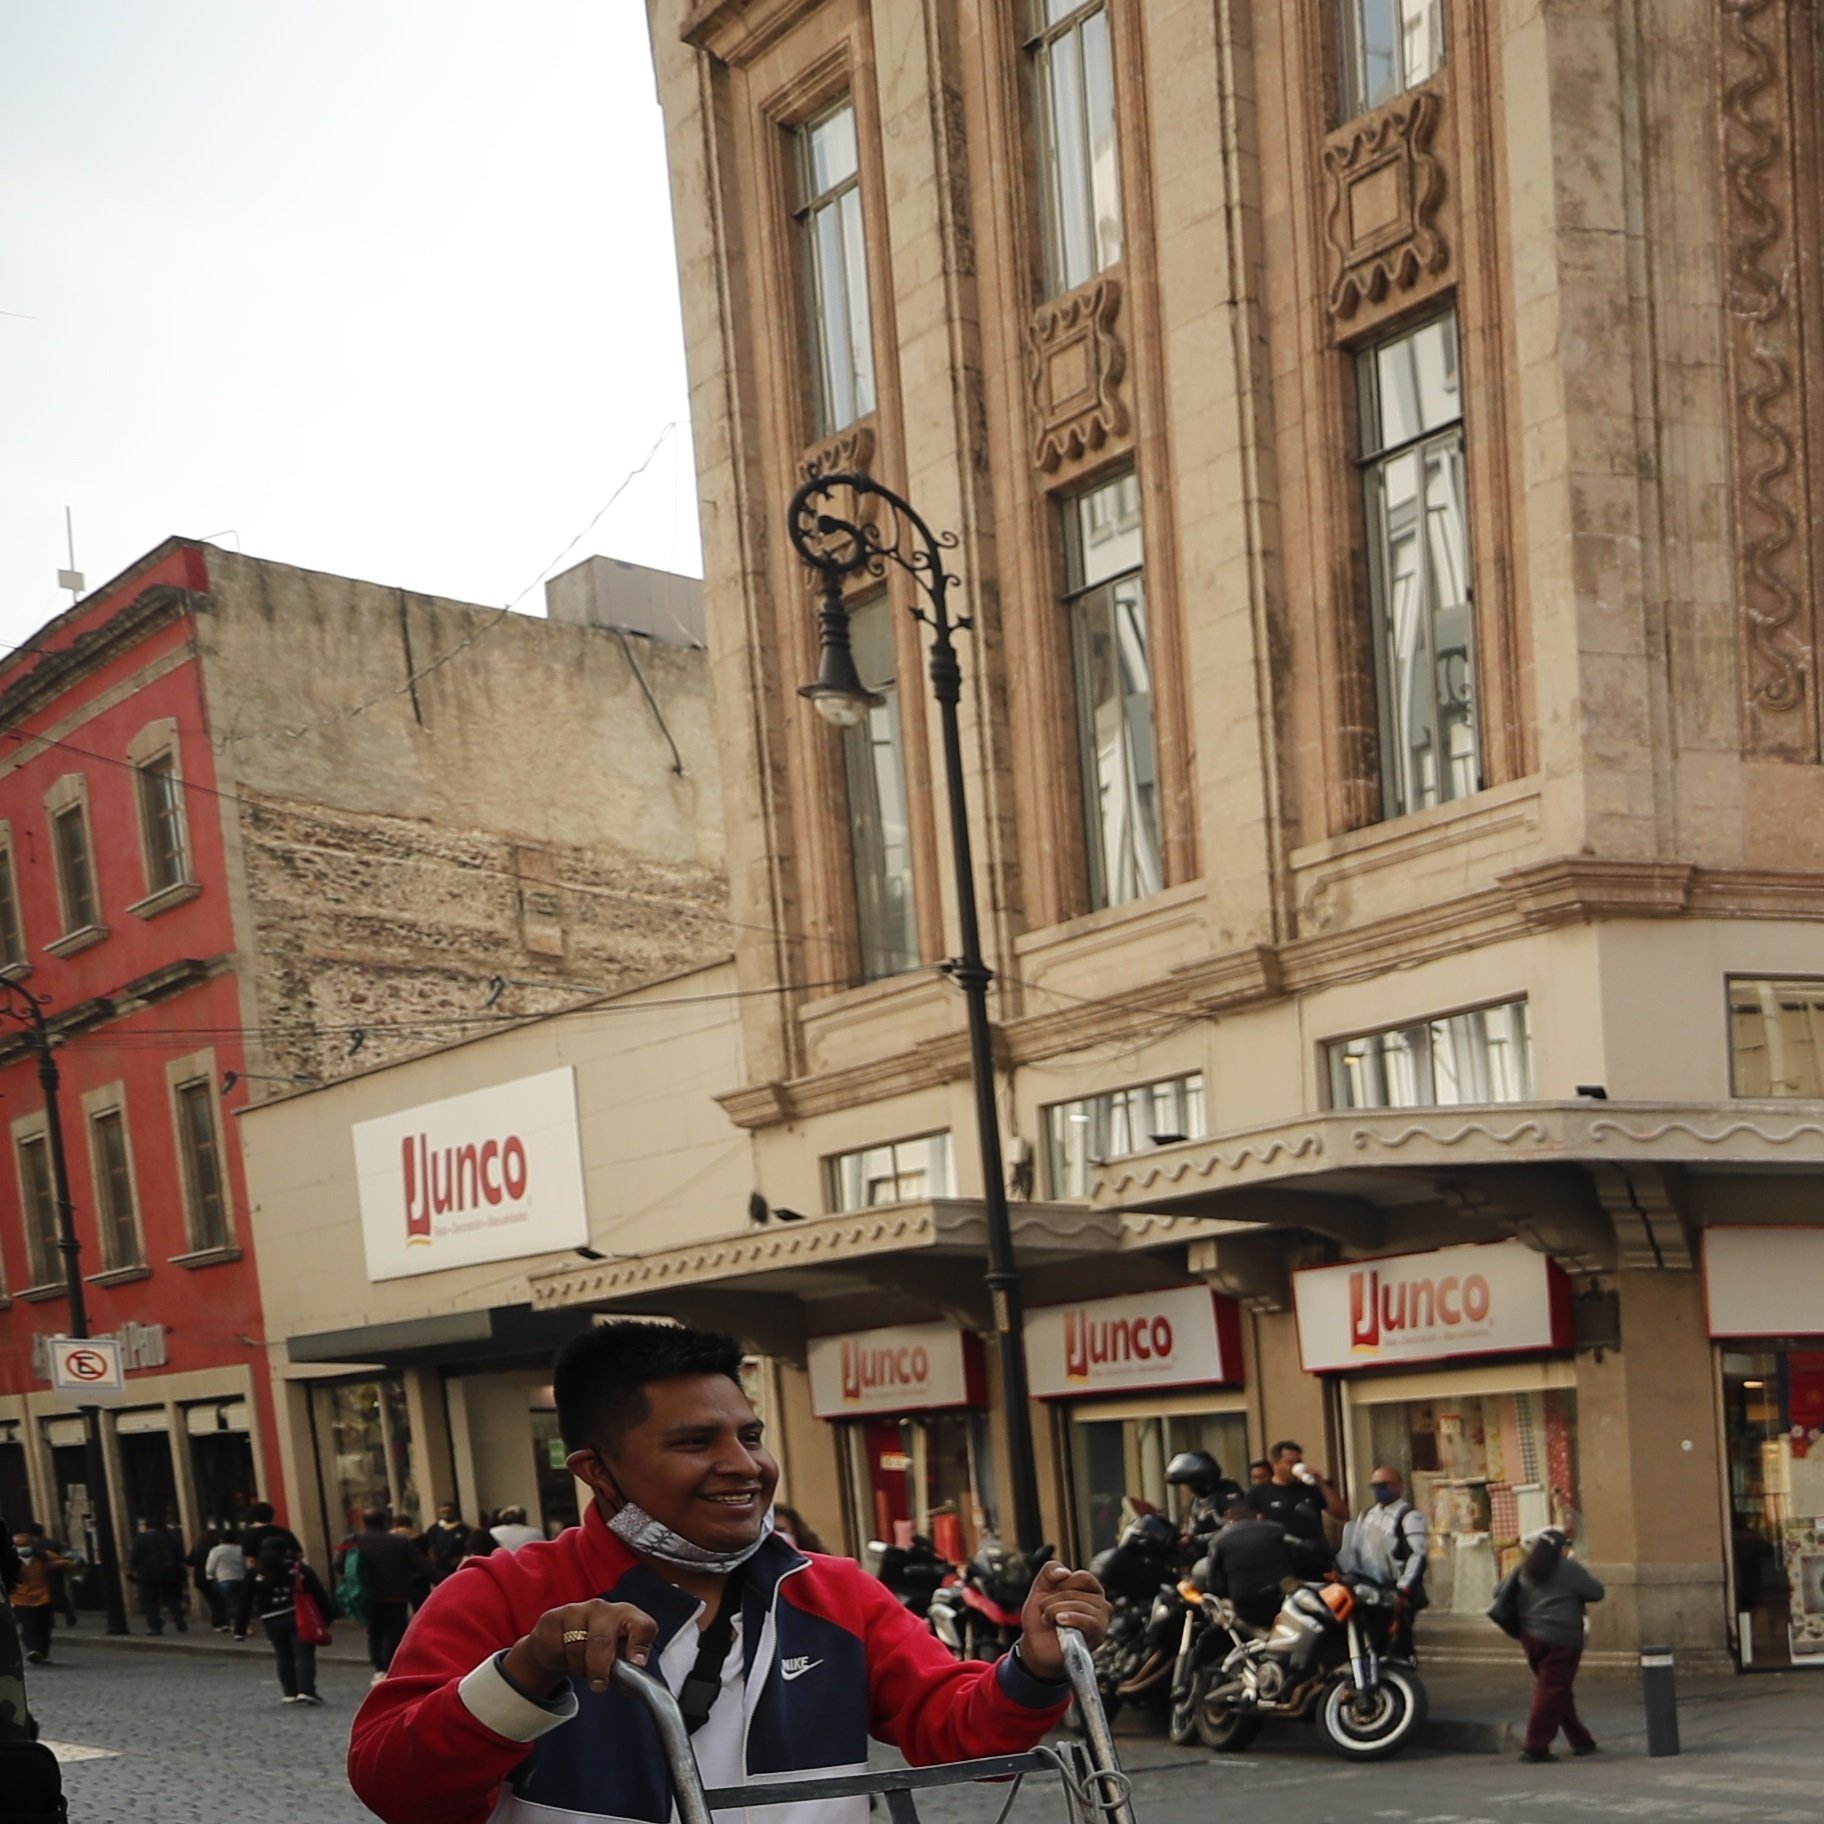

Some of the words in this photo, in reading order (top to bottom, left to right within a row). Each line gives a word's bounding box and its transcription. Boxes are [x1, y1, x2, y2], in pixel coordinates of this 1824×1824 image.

[402, 1133, 527, 1236] Junco
[1064, 1308, 1172, 1376] Junco
[1350, 1270, 1490, 1346] Junco
[841, 1340, 928, 1398] Junco
[781, 1656, 809, 1671] NIKE
